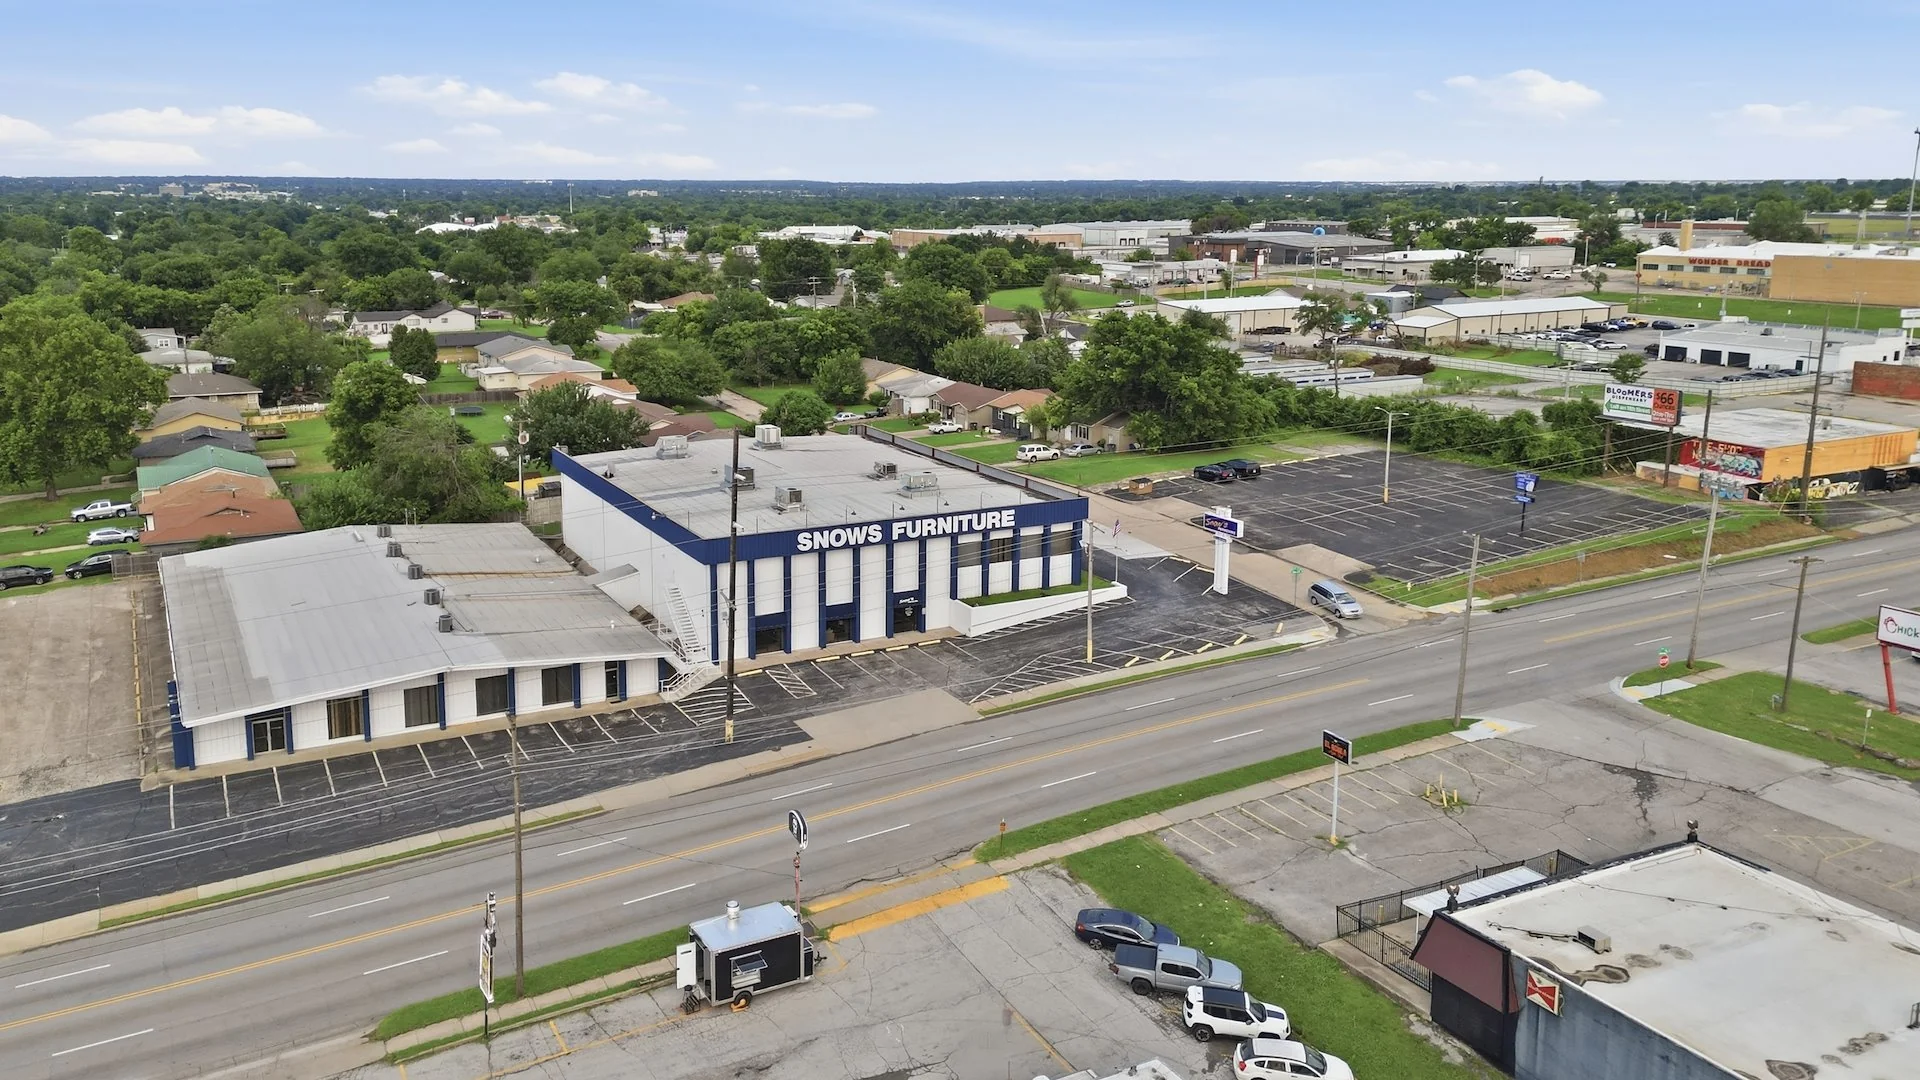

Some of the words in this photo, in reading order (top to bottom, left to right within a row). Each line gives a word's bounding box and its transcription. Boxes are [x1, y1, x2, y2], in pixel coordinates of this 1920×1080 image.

[1656, 392, 1675, 405] $66
[797, 524, 882, 551] SNOWS
[892, 509, 1015, 540] FURNITURE
